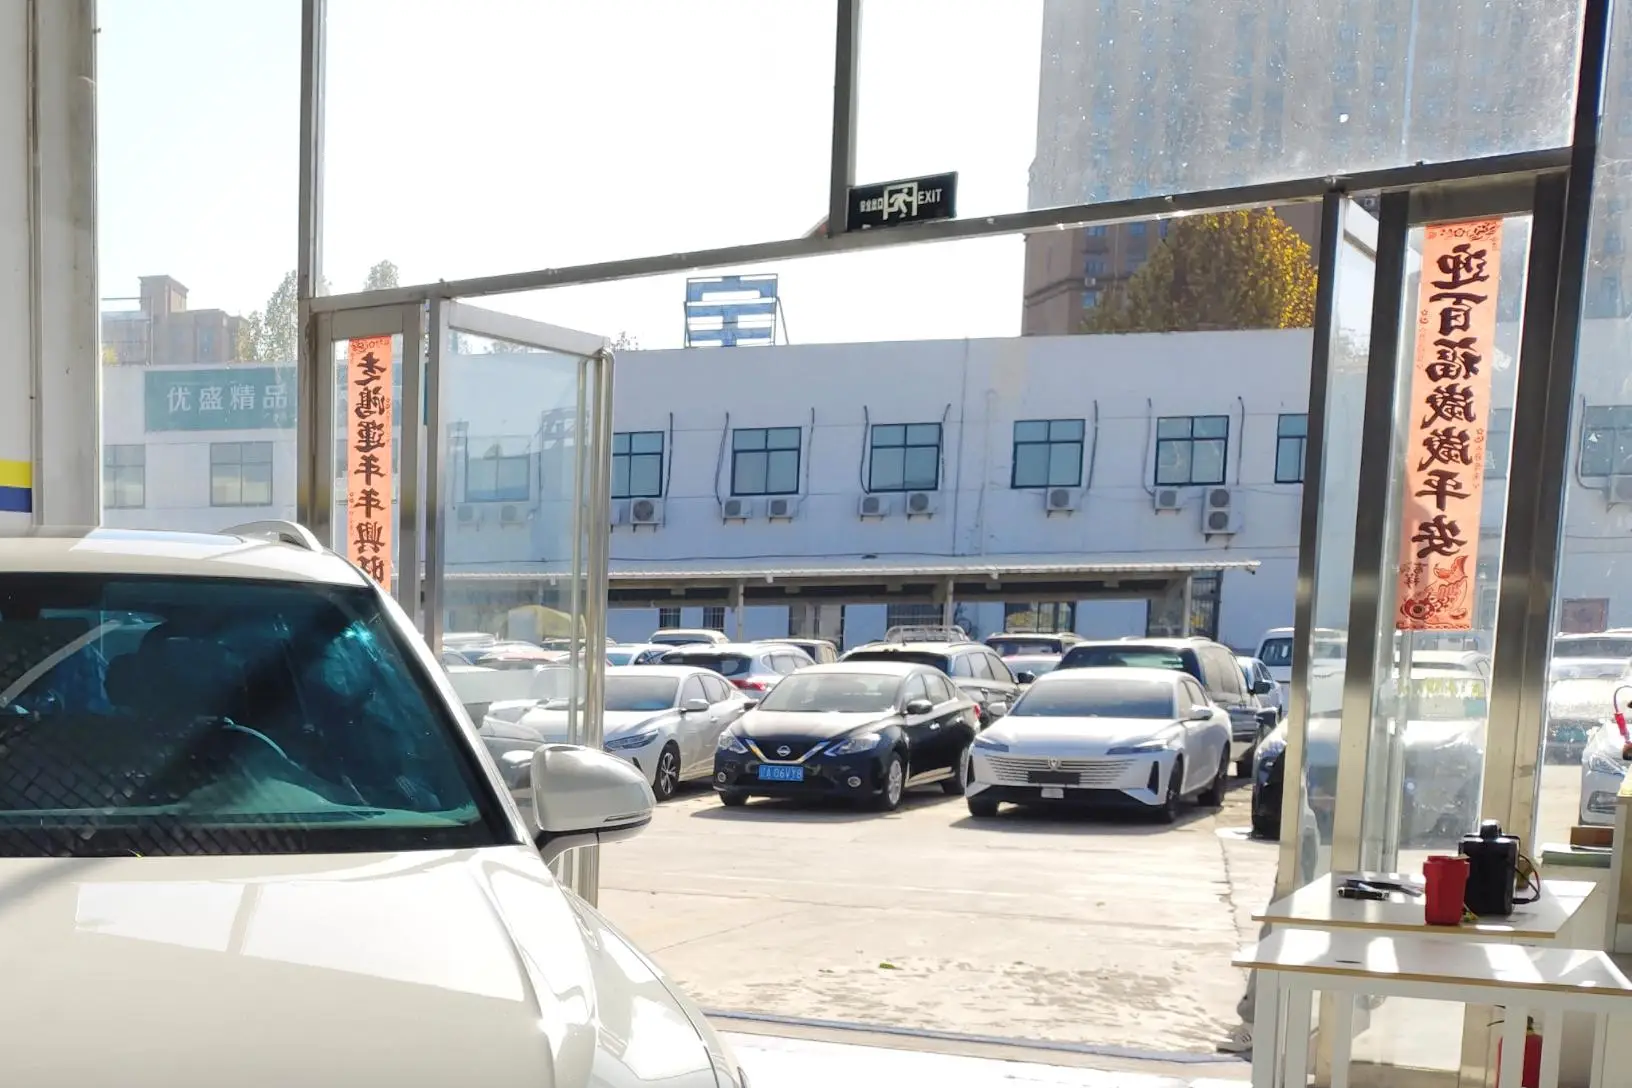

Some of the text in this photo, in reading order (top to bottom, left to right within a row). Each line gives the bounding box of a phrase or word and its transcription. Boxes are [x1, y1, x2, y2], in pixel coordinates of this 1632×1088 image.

[918, 188, 942, 205] EXIT
[167, 384, 288, 413] 优盛精品
